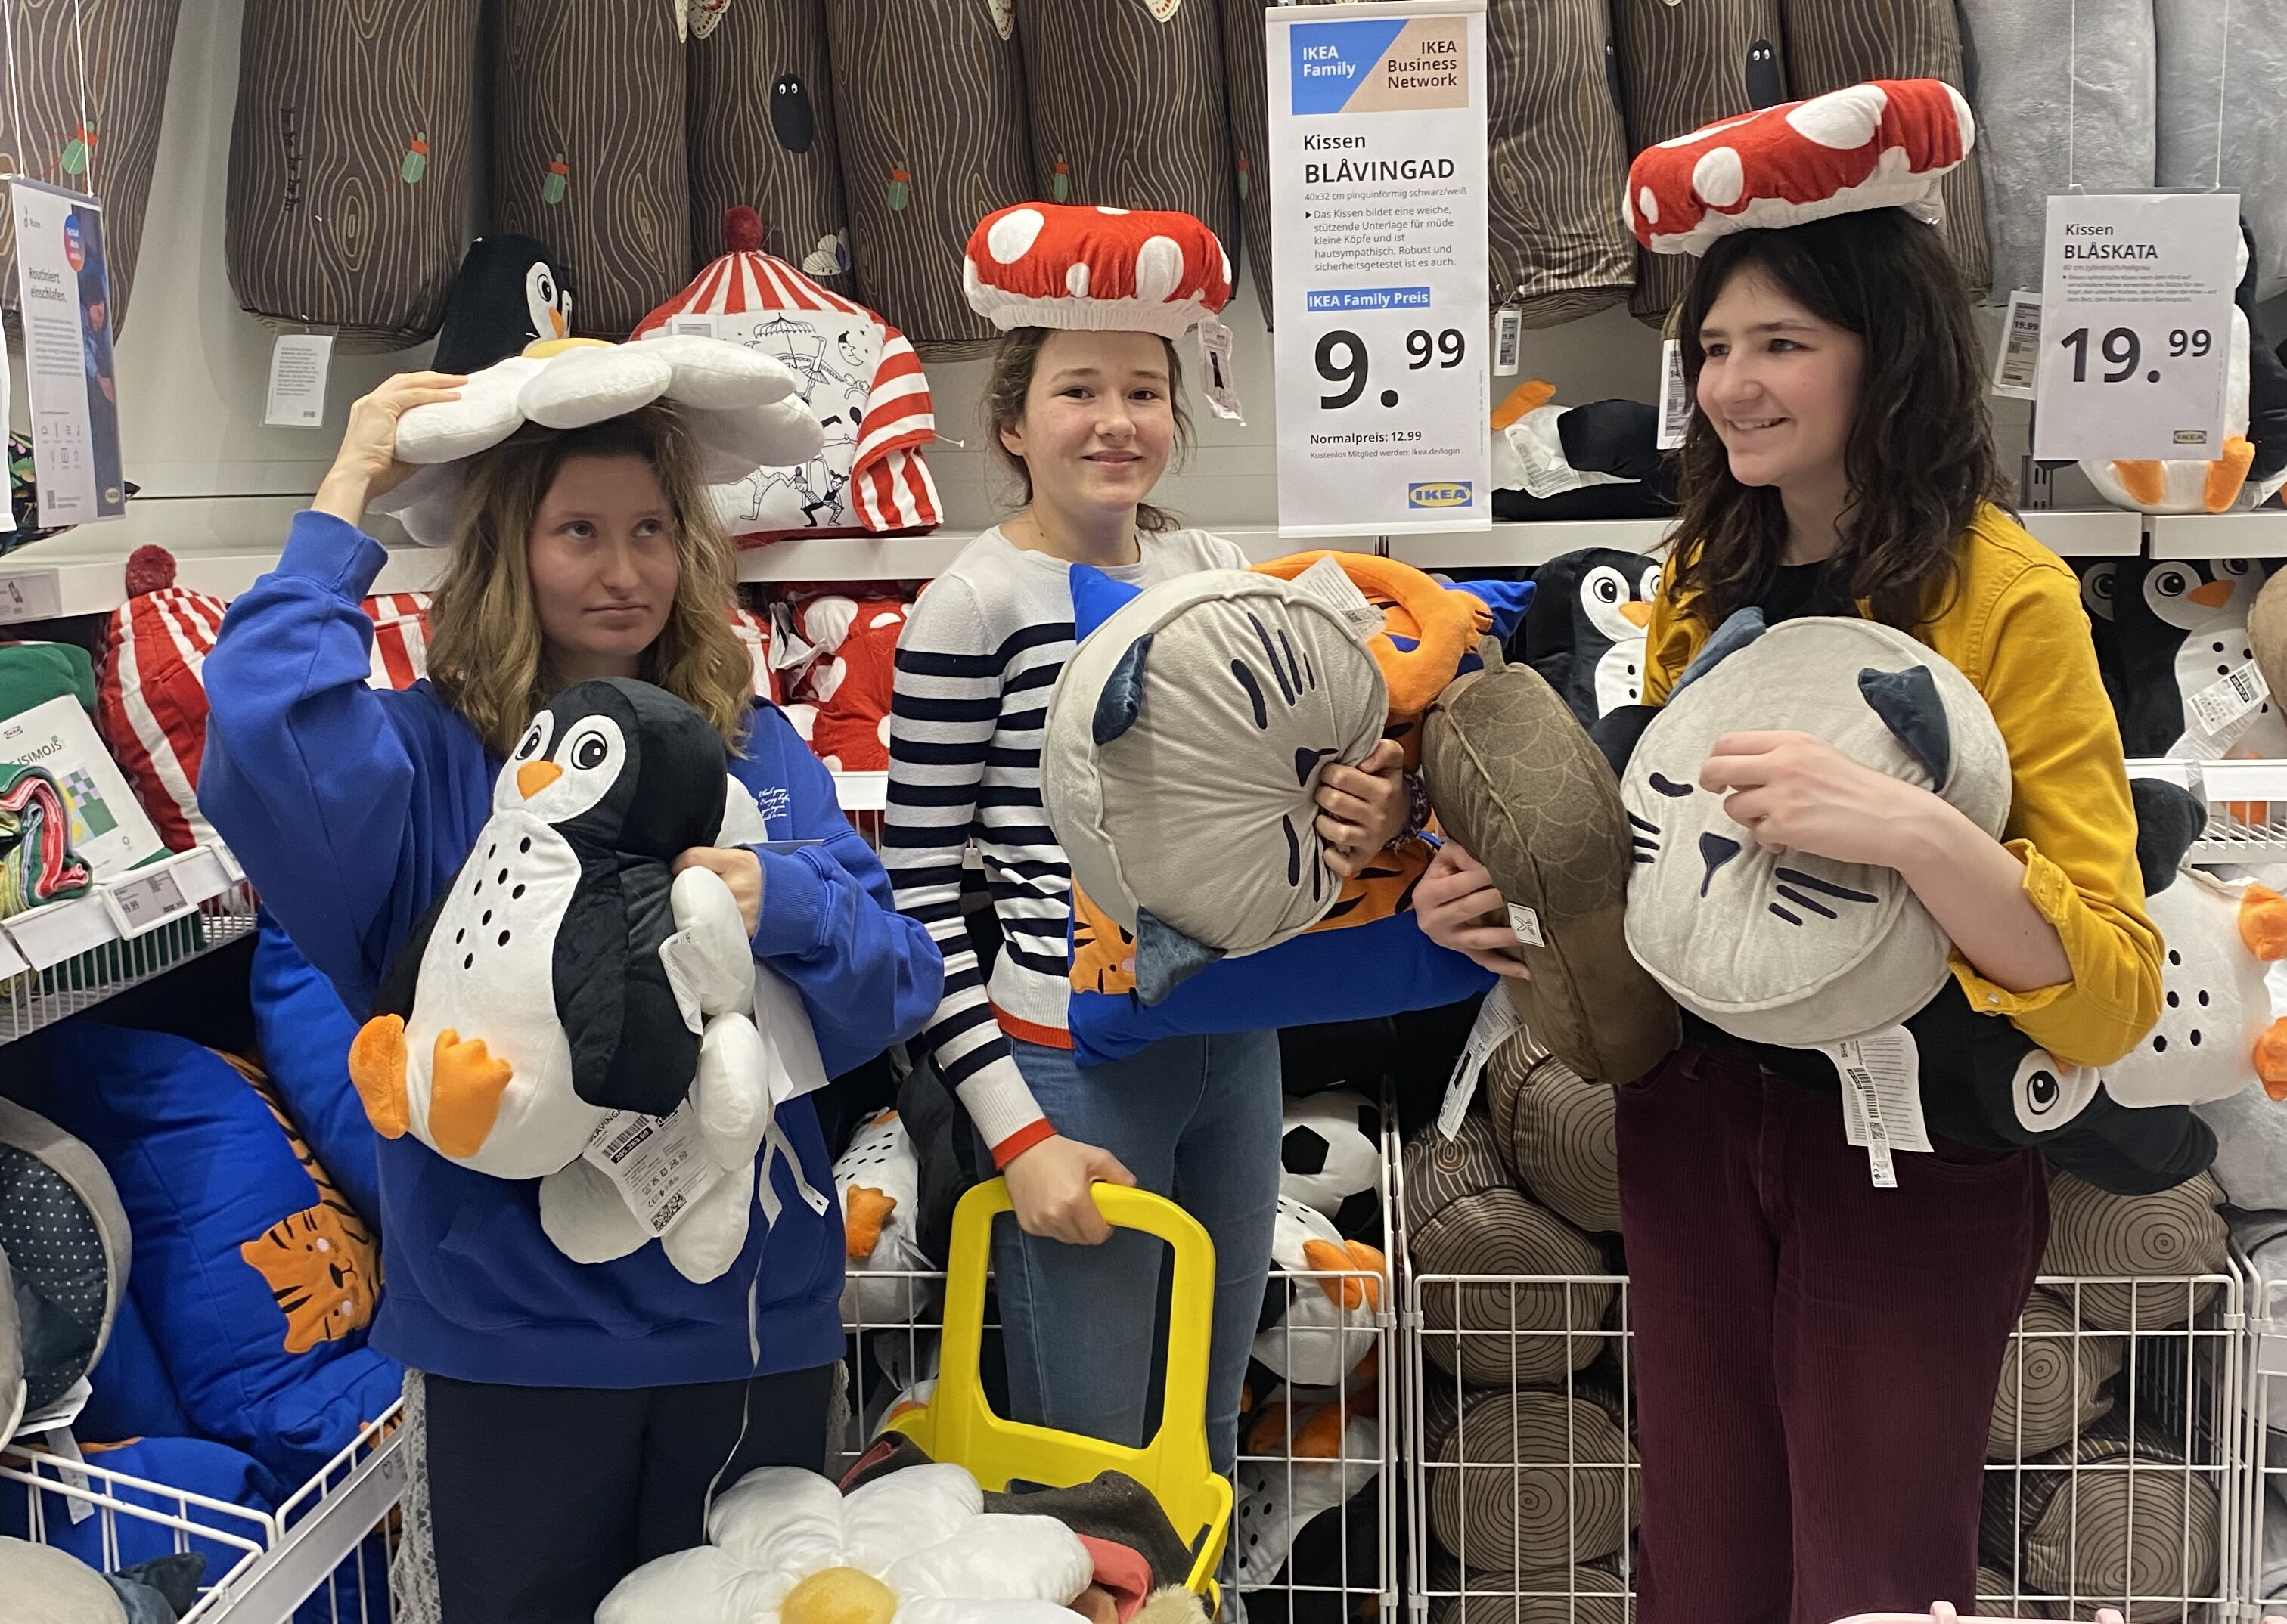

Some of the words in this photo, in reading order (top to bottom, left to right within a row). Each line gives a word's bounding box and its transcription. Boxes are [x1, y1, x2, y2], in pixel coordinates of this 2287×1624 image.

[1303, 46, 1339, 60] IKEA
[1422, 40, 1457, 54] IKEA
[1303, 62, 1356, 79] Family
[1388, 57, 1457, 73] Business
[1388, 73, 1457, 89] Network
[1304, 135, 1366, 150] Kissen
[1305, 158, 1455, 184] BLÅVINGAD
[1305, 192, 1330, 200] 40x32
[1347, 189, 1407, 201] pinguinförmig
[1409, 187, 1467, 197] schwarz/weiß
[1314, 210, 1332, 218] Das
[1333, 209, 1363, 218] Kissen
[1366, 207, 1392, 217] bildet
[1395, 207, 1414, 215] eine
[1417, 206, 1452, 215] weiche,
[1314, 222, 1361, 232] stützende
[1362, 220, 1408, 232] Unterlage
[1410, 219, 1425, 228] für
[1426, 218, 1454, 228] müde
[2065, 224, 2115, 236] Kissen
[1314, 235, 1342, 245] kleine
[1344, 234, 1371, 245] Köpfe
[1373, 234, 1392, 243] und
[1394, 233, 1405, 242] ist
[1314, 246, 1396, 259] hautsympathisch.
[1398, 246, 1431, 255] Robust
[2064, 242, 2158, 259] BLÅSKATA
[1315, 260, 1402, 273] sicherheitsgetestet
[1431, 258, 1456, 266] auch.
[1308, 295, 1340, 308] IKEA
[1344, 293, 1391, 308] Family
[1394, 292, 1429, 305] Preis
[1310, 432, 1389, 445] Normalpreis:
[1392, 431, 1422, 442] 12.99
[1348, 450, 1378, 459] Mitglied
[1415, 489, 1468, 501] IKEA
